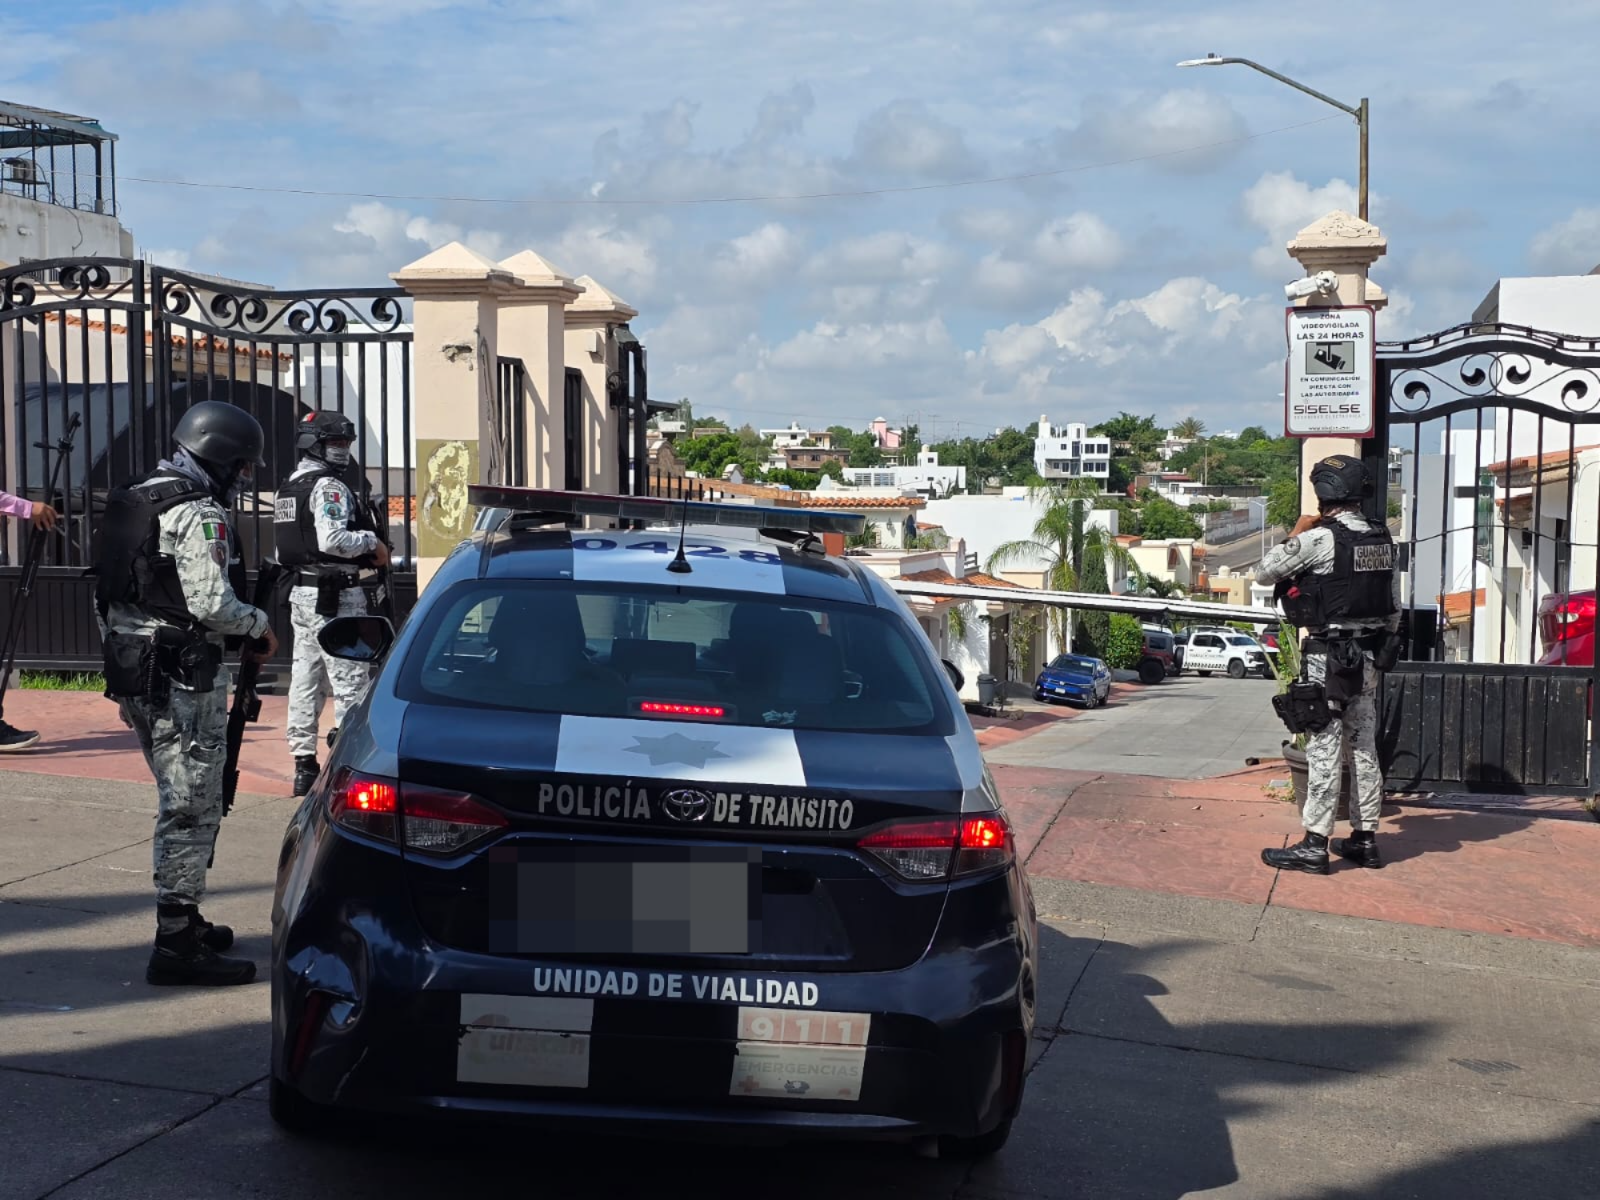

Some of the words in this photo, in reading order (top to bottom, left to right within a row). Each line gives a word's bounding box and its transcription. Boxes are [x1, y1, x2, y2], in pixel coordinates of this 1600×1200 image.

[1301, 322, 1360, 330] VIDEOVIGILADA
[1331, 331, 1364, 339] HORAS
[1294, 404, 1361, 414] SISELSE
[573, 538, 783, 566] 0428
[1357, 545, 1390, 558] GUARDIA
[1355, 557, 1392, 570] NACIONAL
[538, 779, 651, 819] POLICÍA
[713, 792, 742, 824] DE
[533, 967, 639, 996] UNIDAD
[648, 973, 682, 998] DE
[692, 976, 819, 1006] VIALIDAD
[751, 1017, 853, 1046] 911
[737, 1060, 859, 1077] EMERGENCIAS
